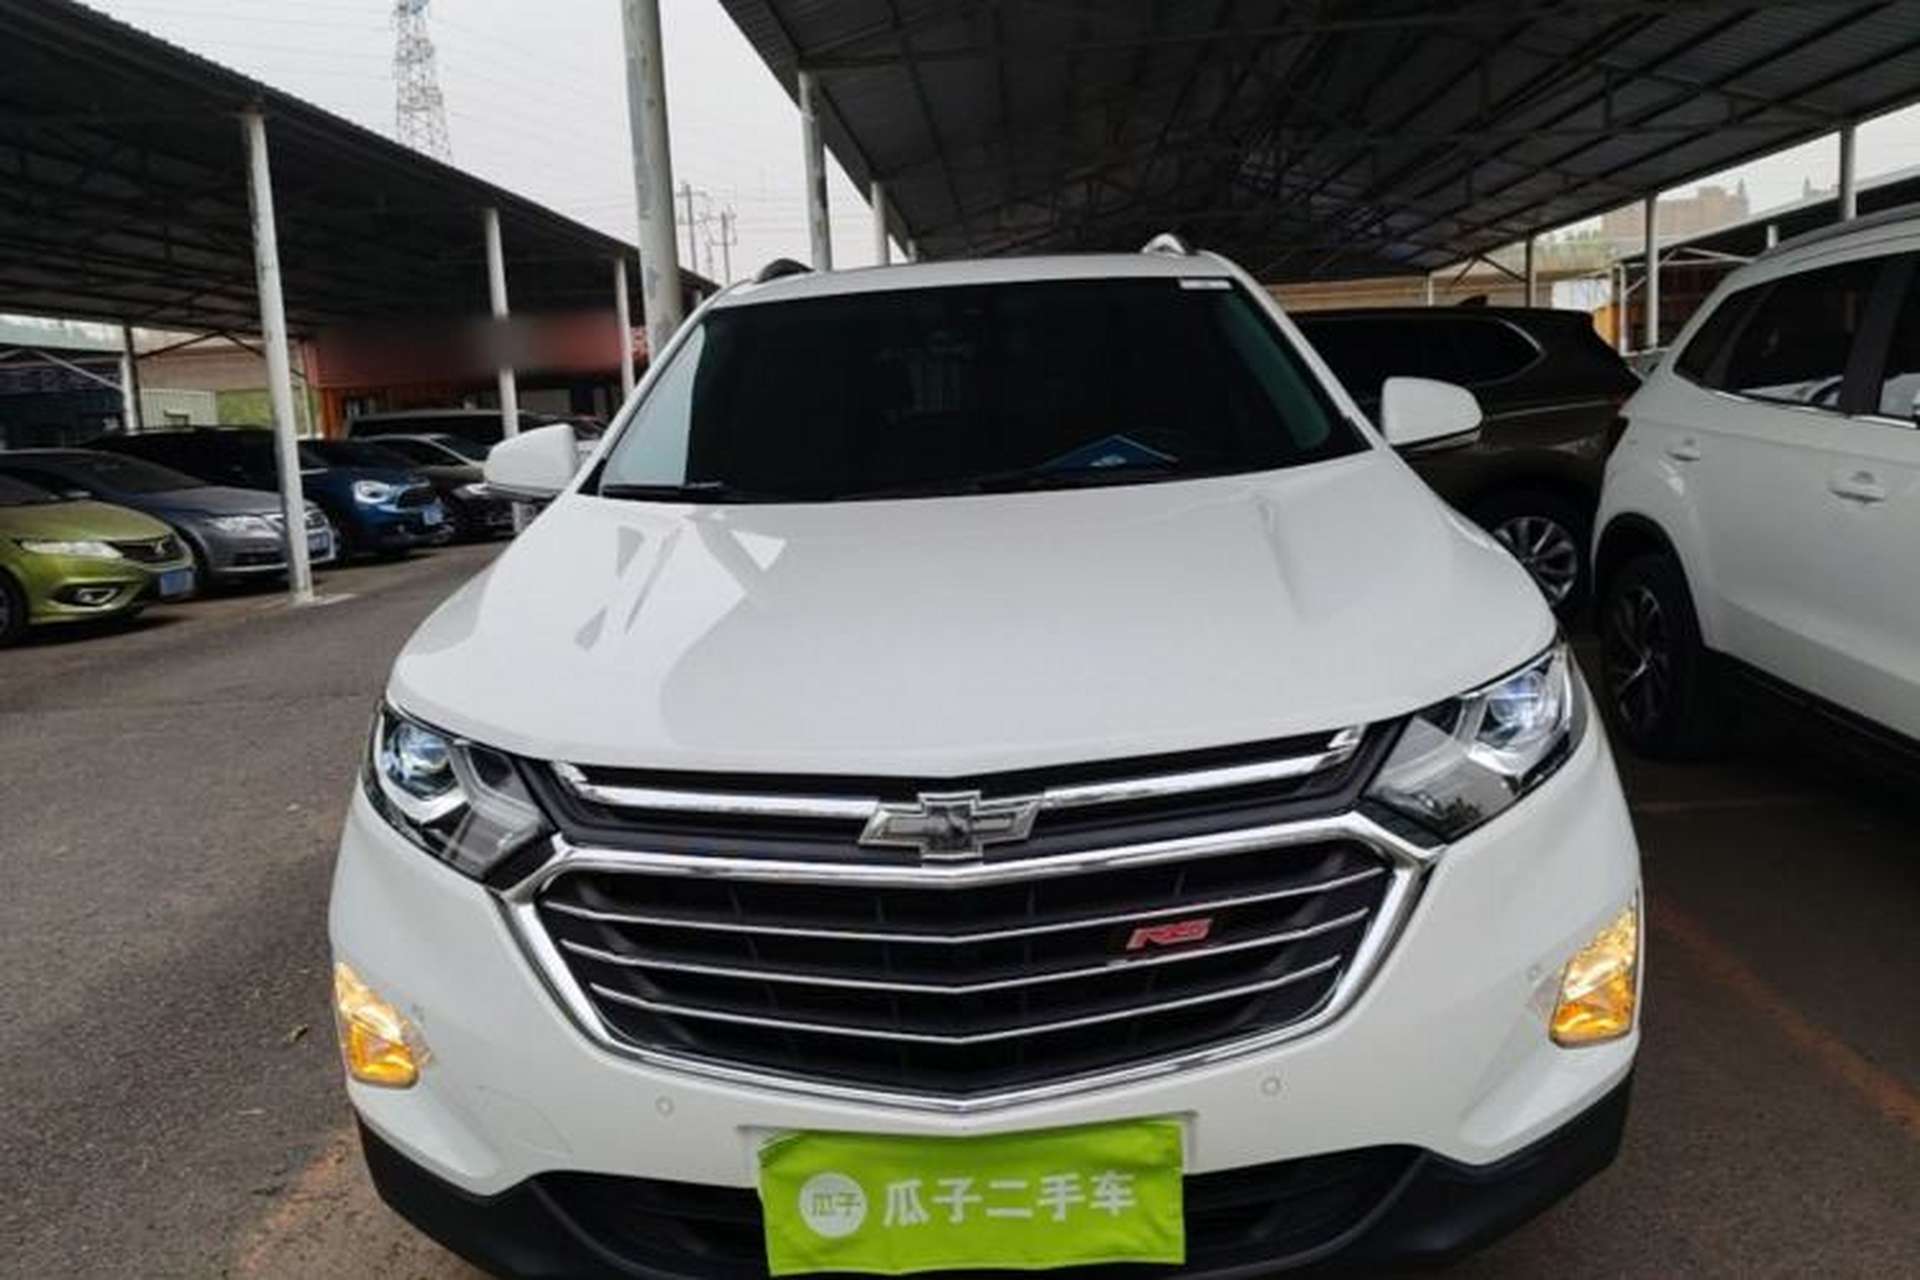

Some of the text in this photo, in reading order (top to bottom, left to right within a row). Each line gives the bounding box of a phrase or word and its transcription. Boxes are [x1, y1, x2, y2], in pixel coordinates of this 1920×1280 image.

[1126, 918, 1213, 950] RS
[882, 1171, 1137, 1227] 瓜子二手车
